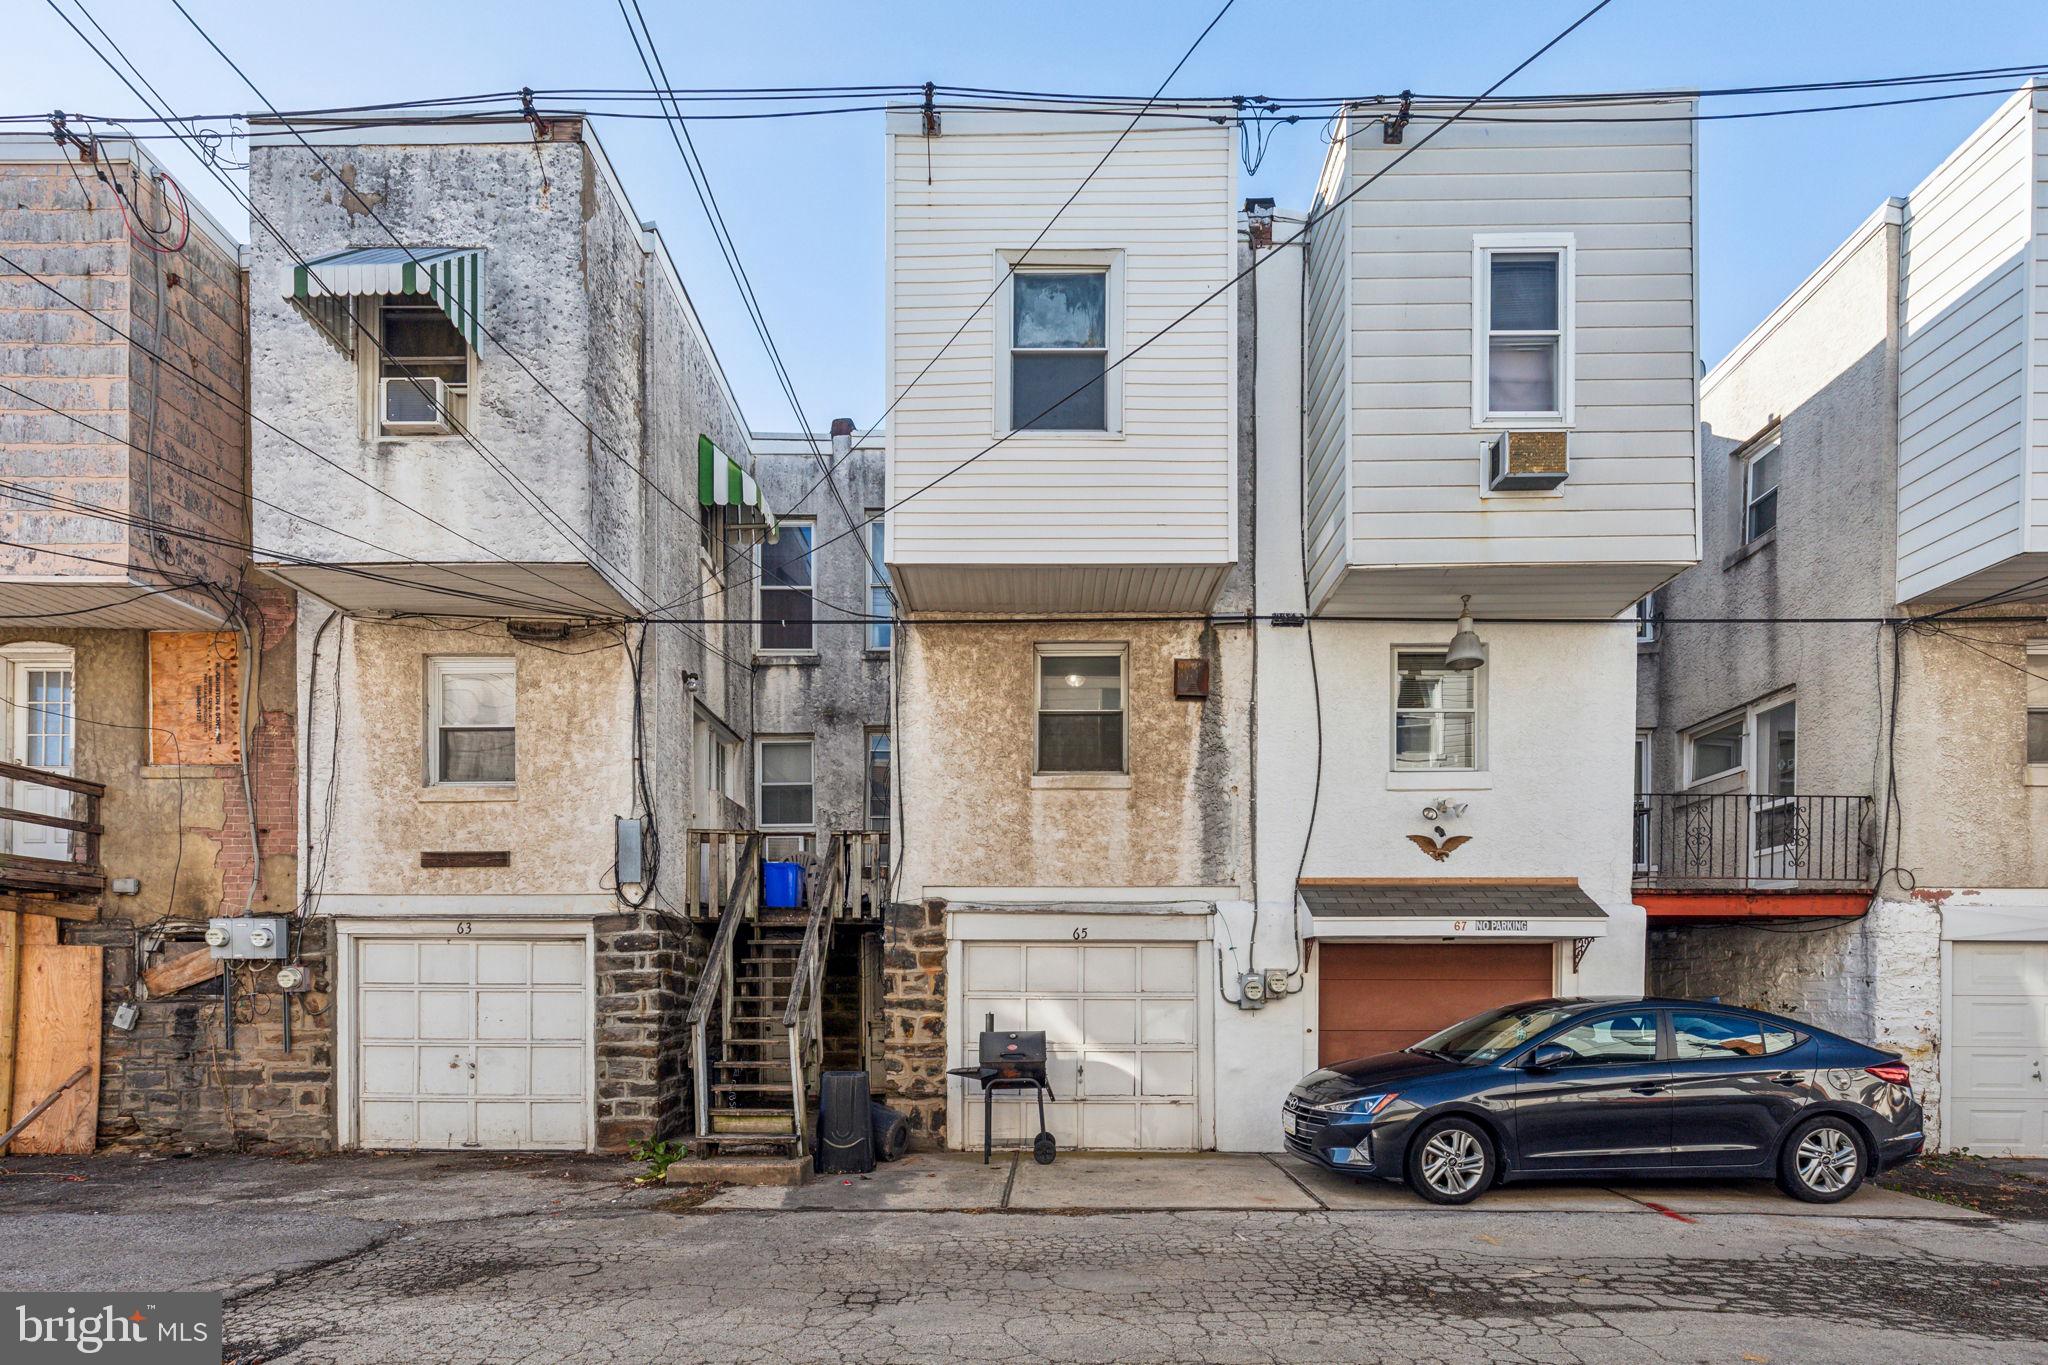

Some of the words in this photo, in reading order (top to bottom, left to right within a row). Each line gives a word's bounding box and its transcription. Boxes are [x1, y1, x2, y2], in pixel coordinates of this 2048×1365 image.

[456, 922, 471, 935] 63
[1454, 921, 1467, 931] 67
[1476, 920, 1490, 931] NO
[1491, 920, 1527, 931] PARKING
[1072, 927, 1088, 940] 65
